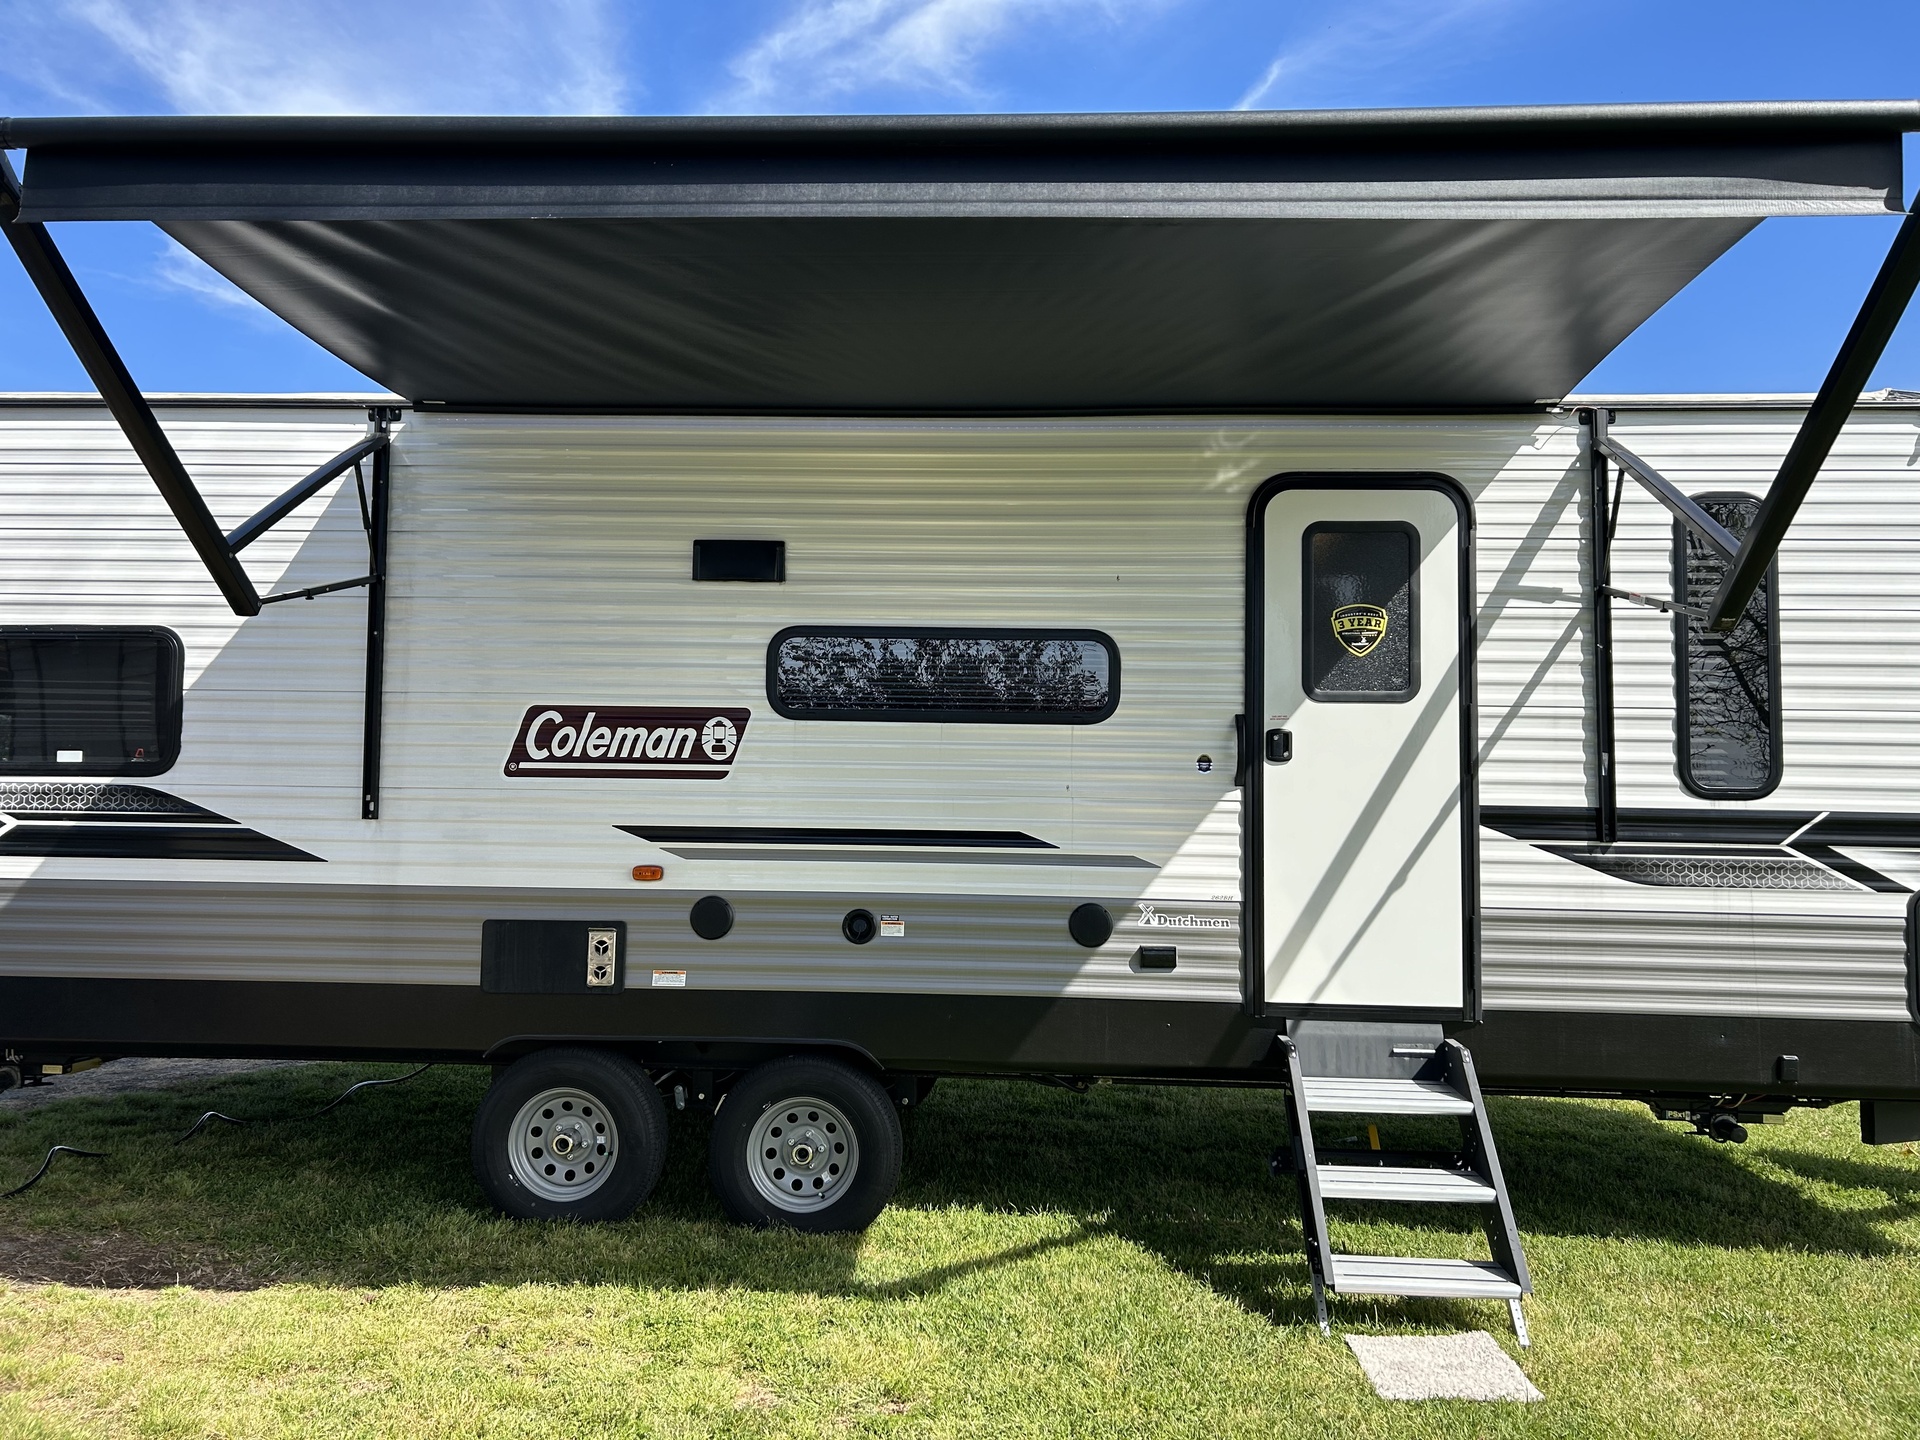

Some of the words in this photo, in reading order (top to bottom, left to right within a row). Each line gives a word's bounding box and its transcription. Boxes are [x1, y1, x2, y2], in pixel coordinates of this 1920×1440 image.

[1337, 620, 1345, 629] 3
[1348, 617, 1382, 628] YEAR
[525, 710, 697, 760] Coleman
[1156, 914, 1230, 928] Dutchmen
